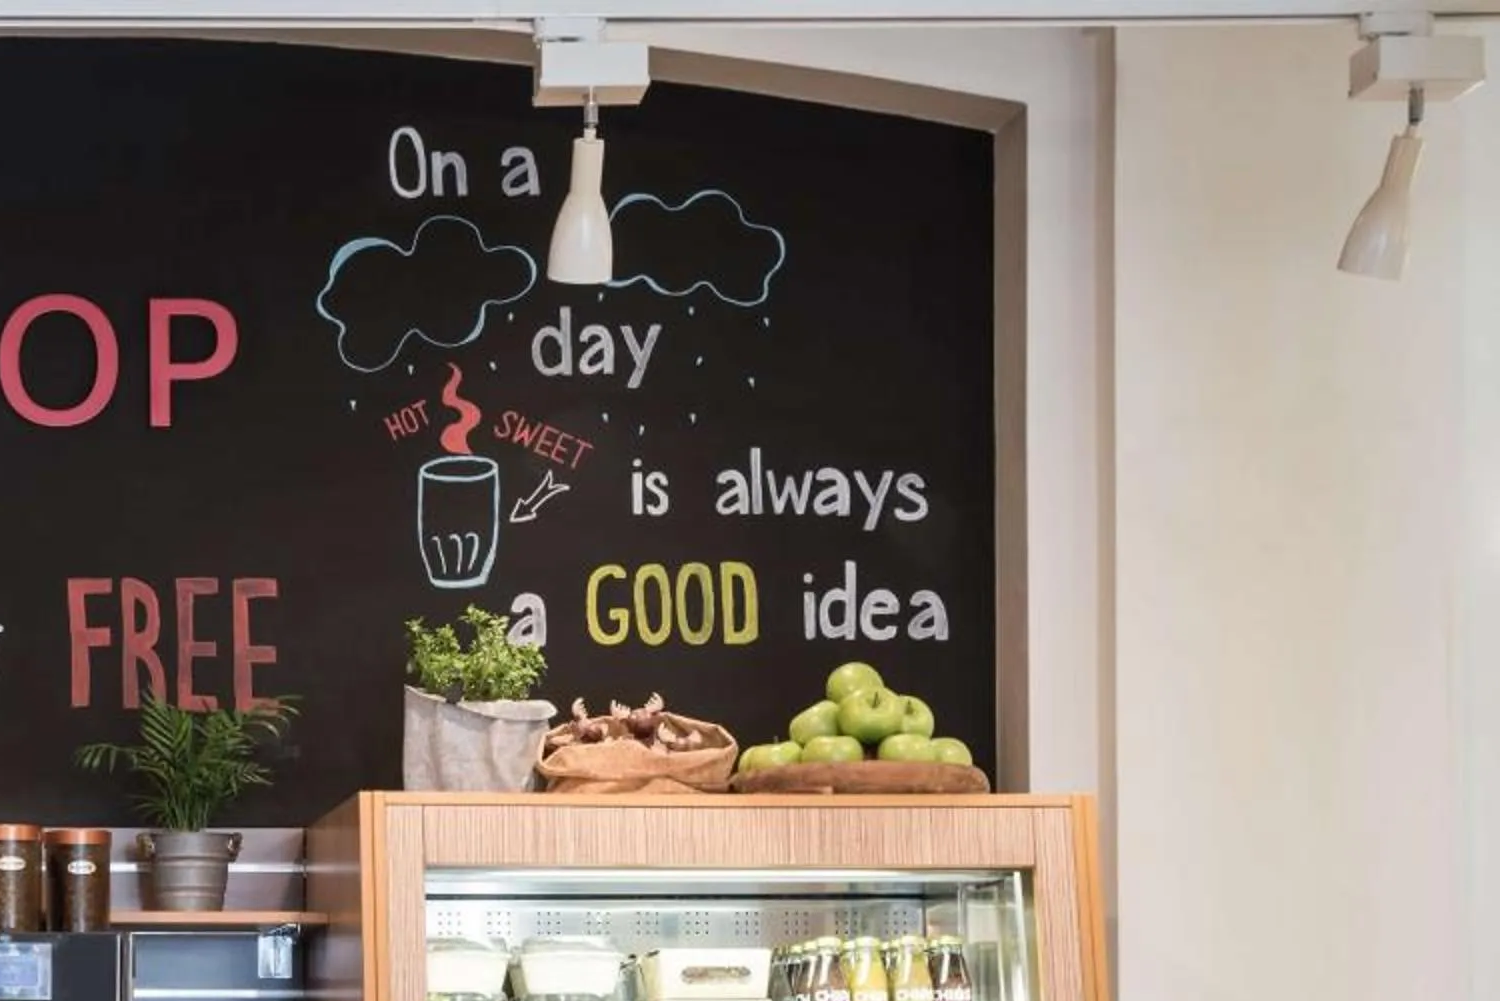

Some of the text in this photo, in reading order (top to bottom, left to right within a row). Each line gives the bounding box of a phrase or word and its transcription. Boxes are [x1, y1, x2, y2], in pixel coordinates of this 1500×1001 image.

[389, 126, 540, 199] On a
[531, 306, 662, 389] day
[384, 400, 430, 441] HOT
[493, 410, 594, 470] SWEET
[631, 447, 929, 531] is always
[67, 577, 280, 715] FREE
[506, 560, 949, 649] a GOOD idea
